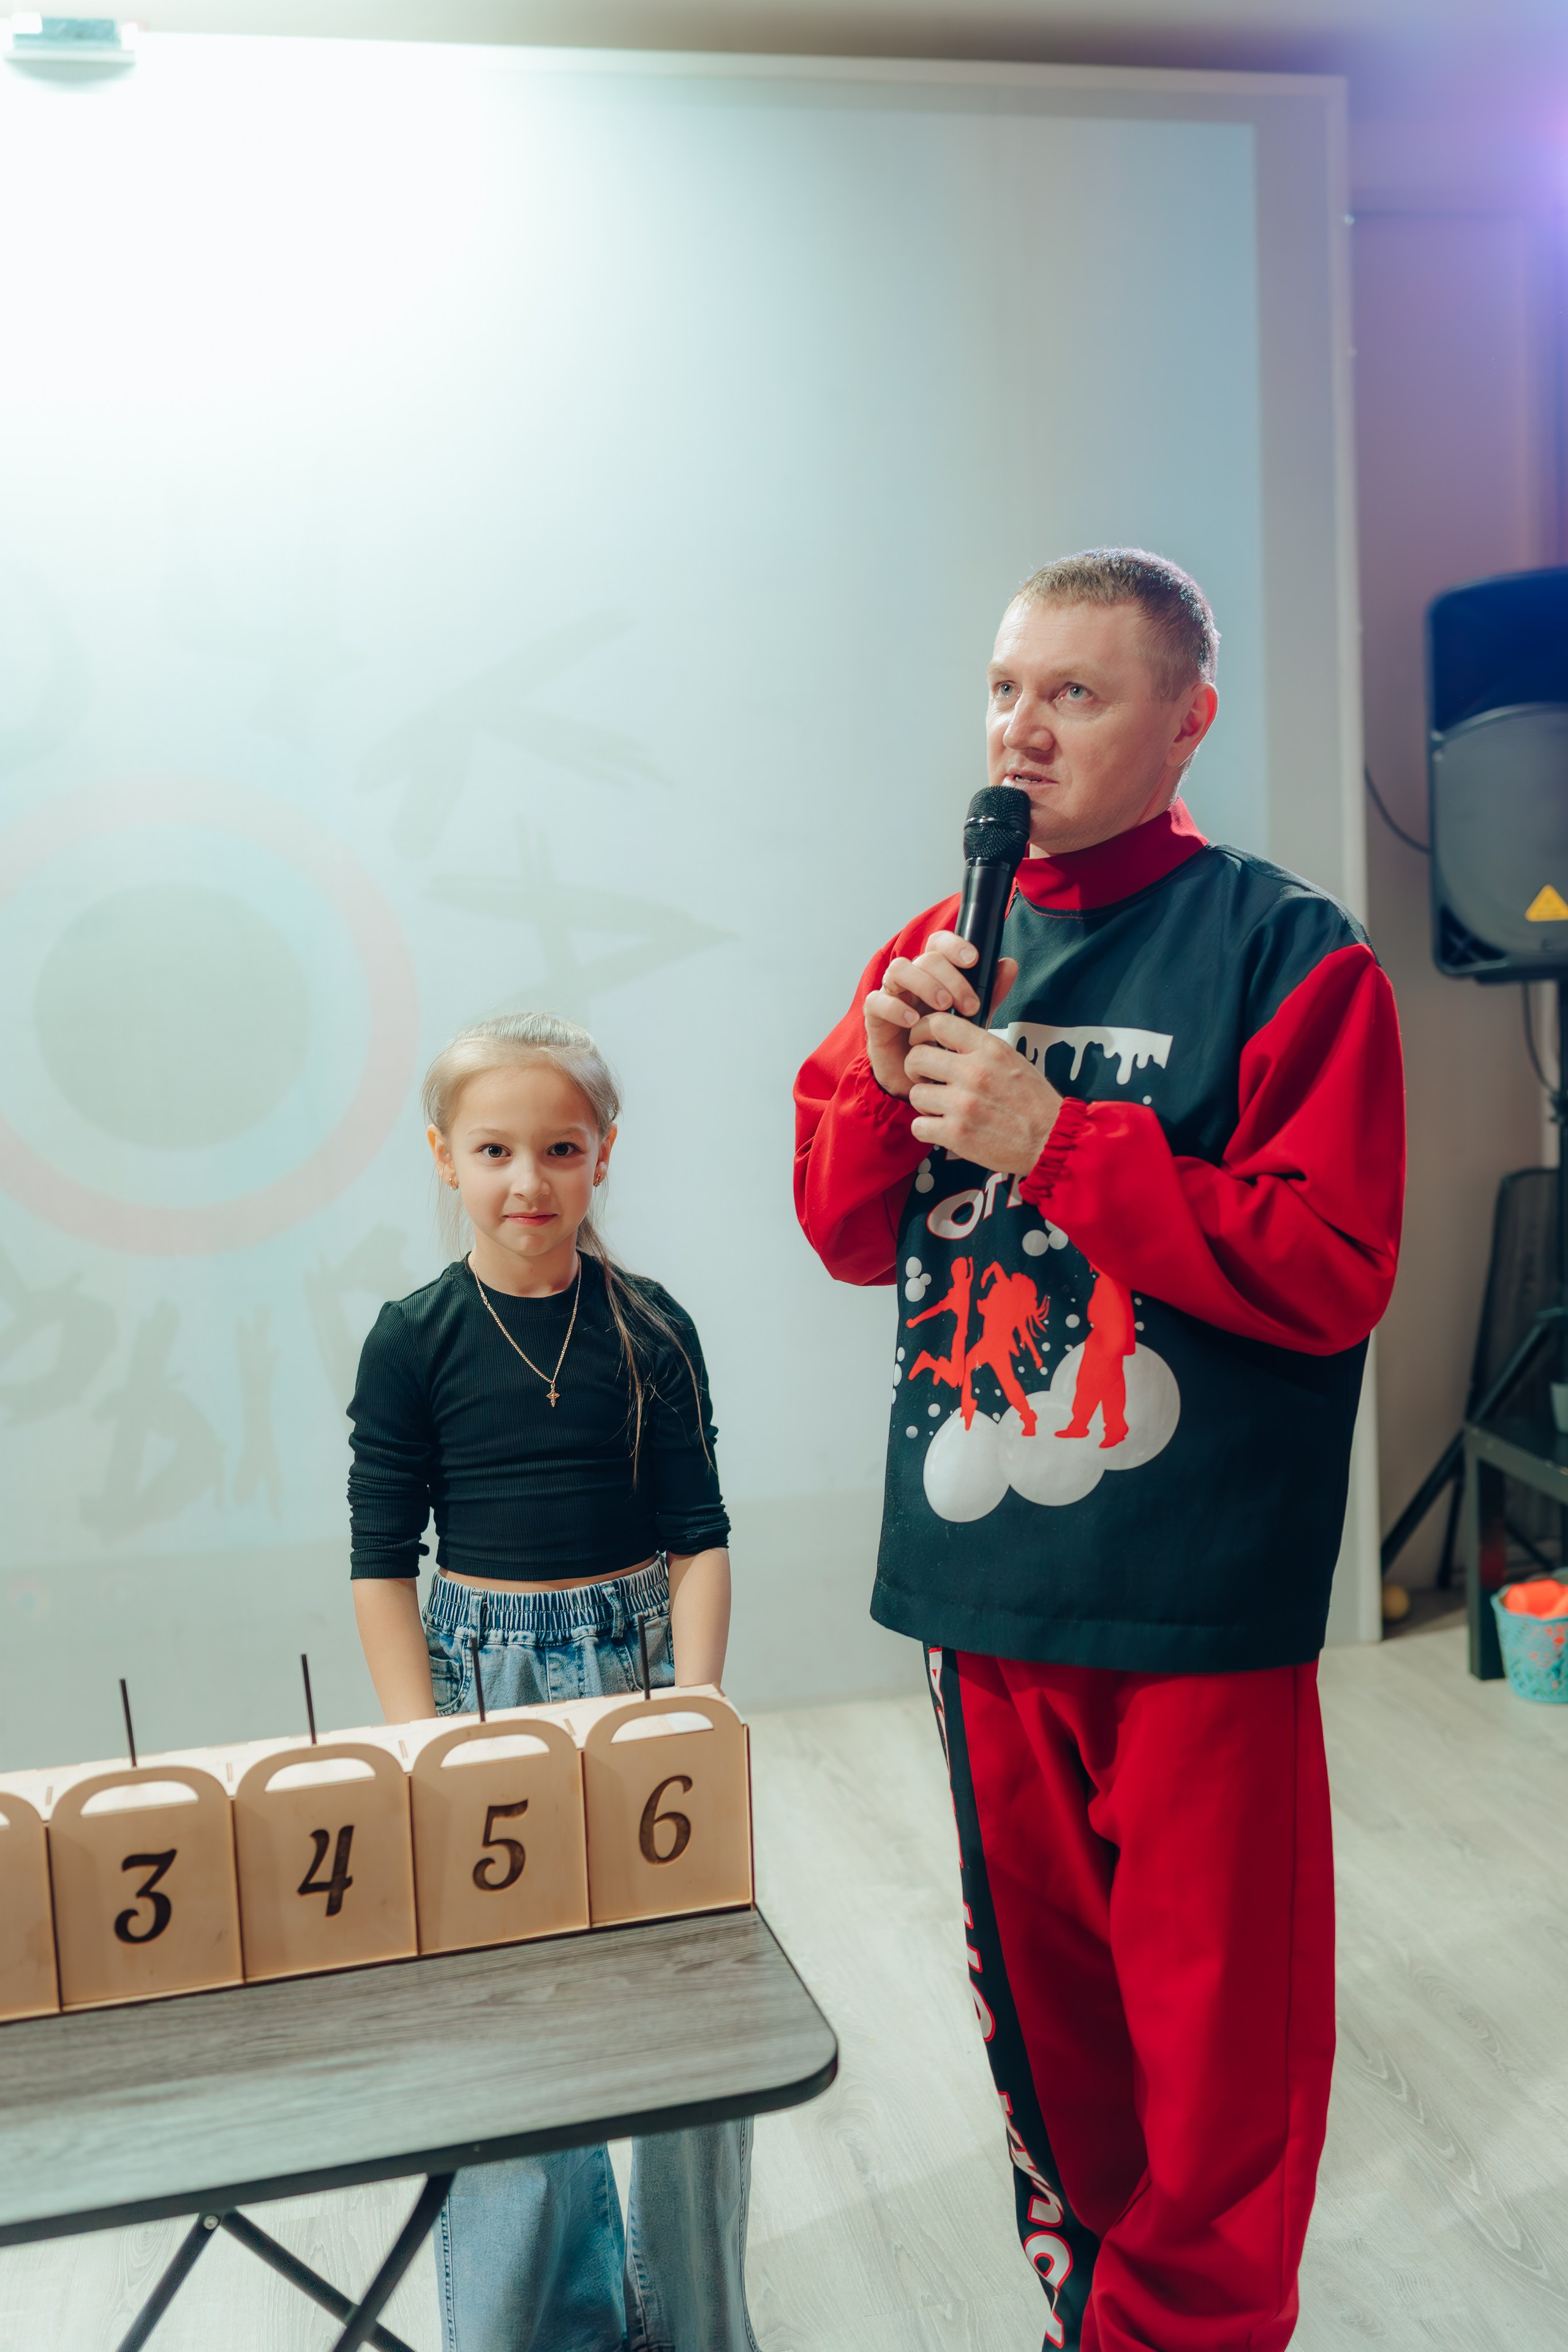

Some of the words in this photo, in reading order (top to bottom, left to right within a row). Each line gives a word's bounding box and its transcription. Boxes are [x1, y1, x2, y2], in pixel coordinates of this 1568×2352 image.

[114, 1848, 178, 1944] 3
[296, 1824, 355, 1917] 4
[472, 1798, 529, 1891] 5
[638, 1774, 693, 1866] 6
